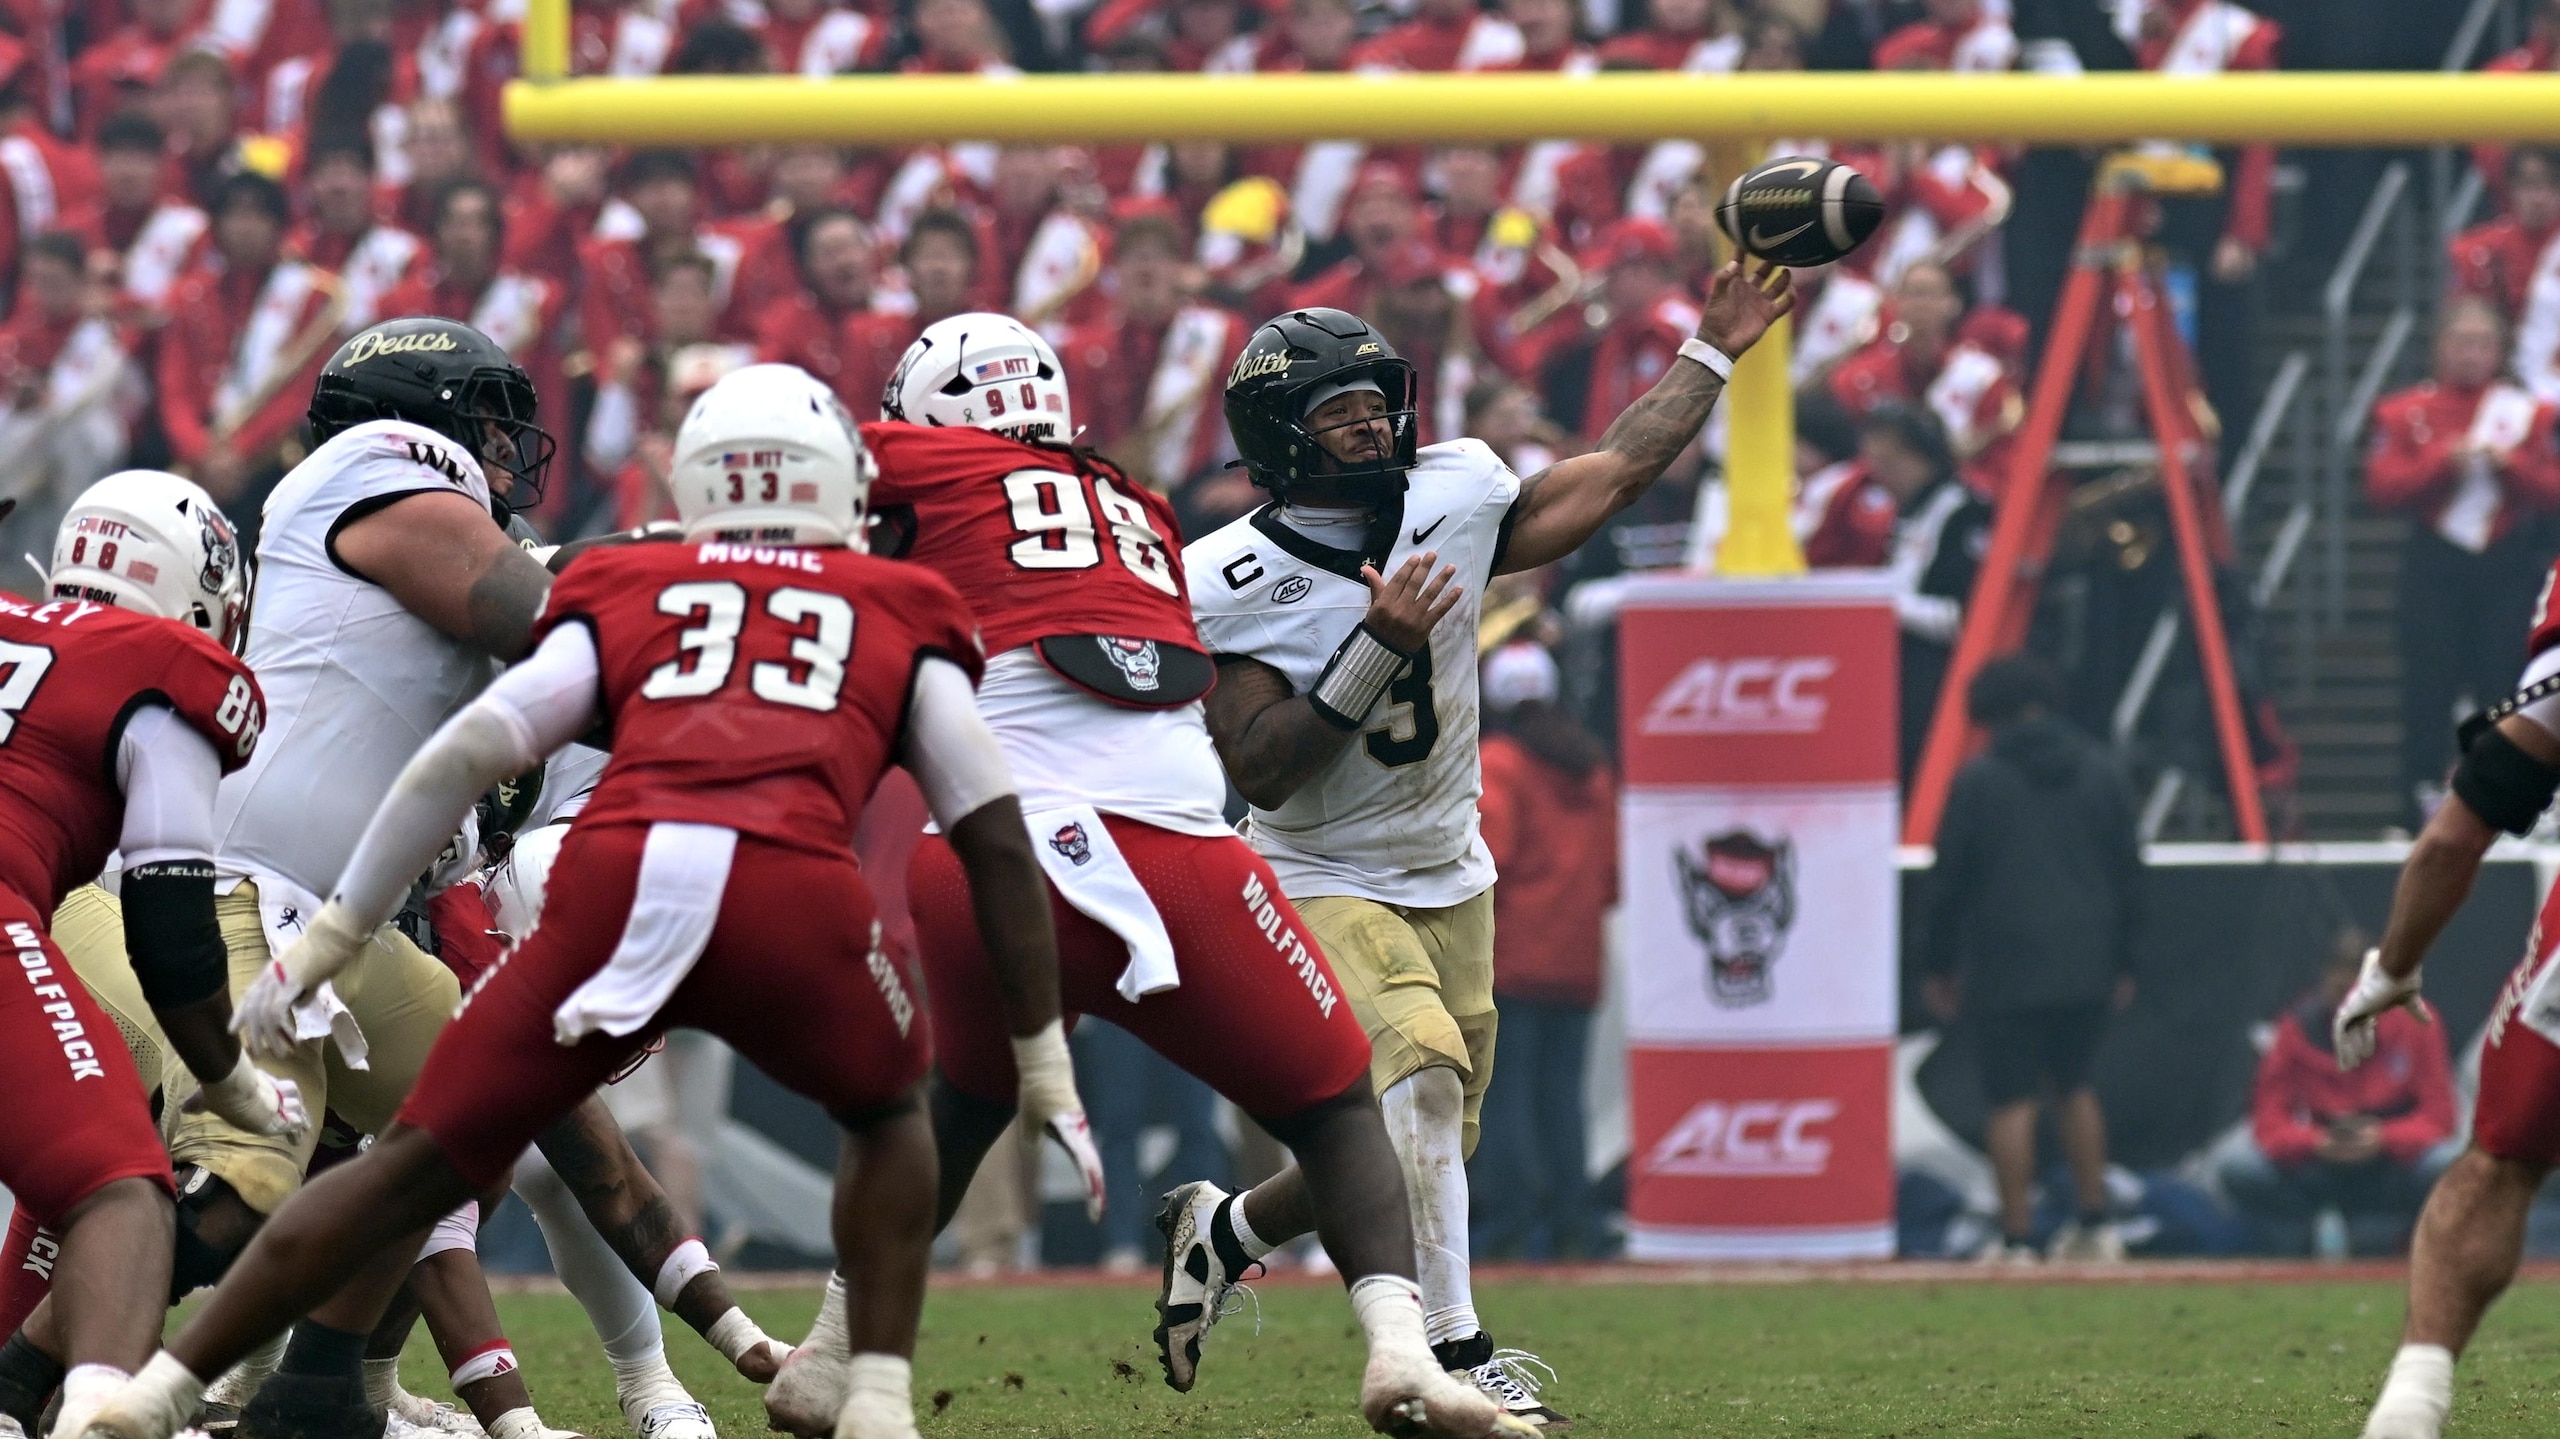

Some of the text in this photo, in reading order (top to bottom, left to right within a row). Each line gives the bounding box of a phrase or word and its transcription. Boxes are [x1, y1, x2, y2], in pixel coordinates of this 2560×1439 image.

[343, 332, 457, 368] Deacs
[1004, 358, 1029, 374] HTT
[1355, 343, 1380, 356] ACC
[98, 519, 129, 539] HTT
[1222, 553, 1264, 590] C
[1279, 578, 1308, 601] ACC
[640, 581, 855, 712] 33
[216, 674, 261, 758] 88
[1362, 634, 1439, 769] 3
[1643, 658, 1837, 733] ACC
[1242, 871, 1338, 1020] WOLFPACK
[4, 922, 105, 1082] WOLFPACK
[1647, 1099, 1840, 1176] ACC
